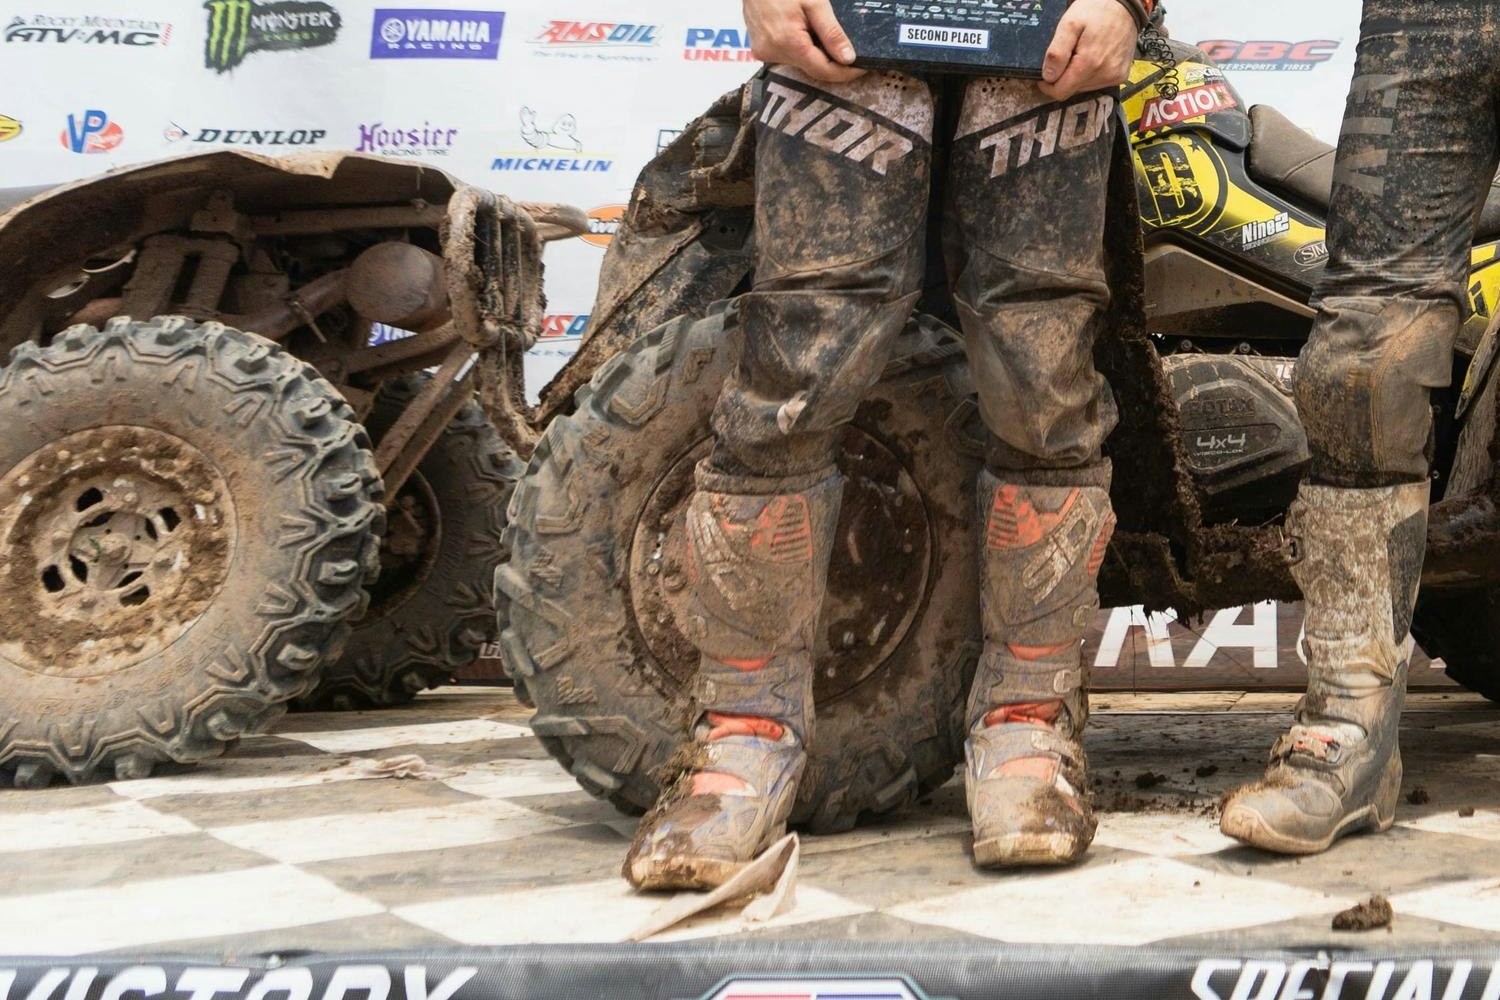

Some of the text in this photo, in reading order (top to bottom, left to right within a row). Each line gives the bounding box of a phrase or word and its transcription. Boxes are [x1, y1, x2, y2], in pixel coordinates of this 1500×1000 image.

[250, 10, 334, 31] MONSTER
[404, 20, 491, 44] YAMAHA
[537, 19, 658, 44] AMSOIL
[387, 42, 484, 52] RACING
[907, 27, 982, 45] SECOND PLACE
[1195, 39, 1341, 63] GBC
[67, 109, 109, 154] VP
[192, 128, 327, 145] DUNLOP
[759, 81, 914, 177] THOR
[979, 94, 1114, 179] THOR
[491, 156, 614, 172] MICHELIN
[1242, 211, 1290, 246] Nine2
[1196, 432, 1247, 449] 4x4
